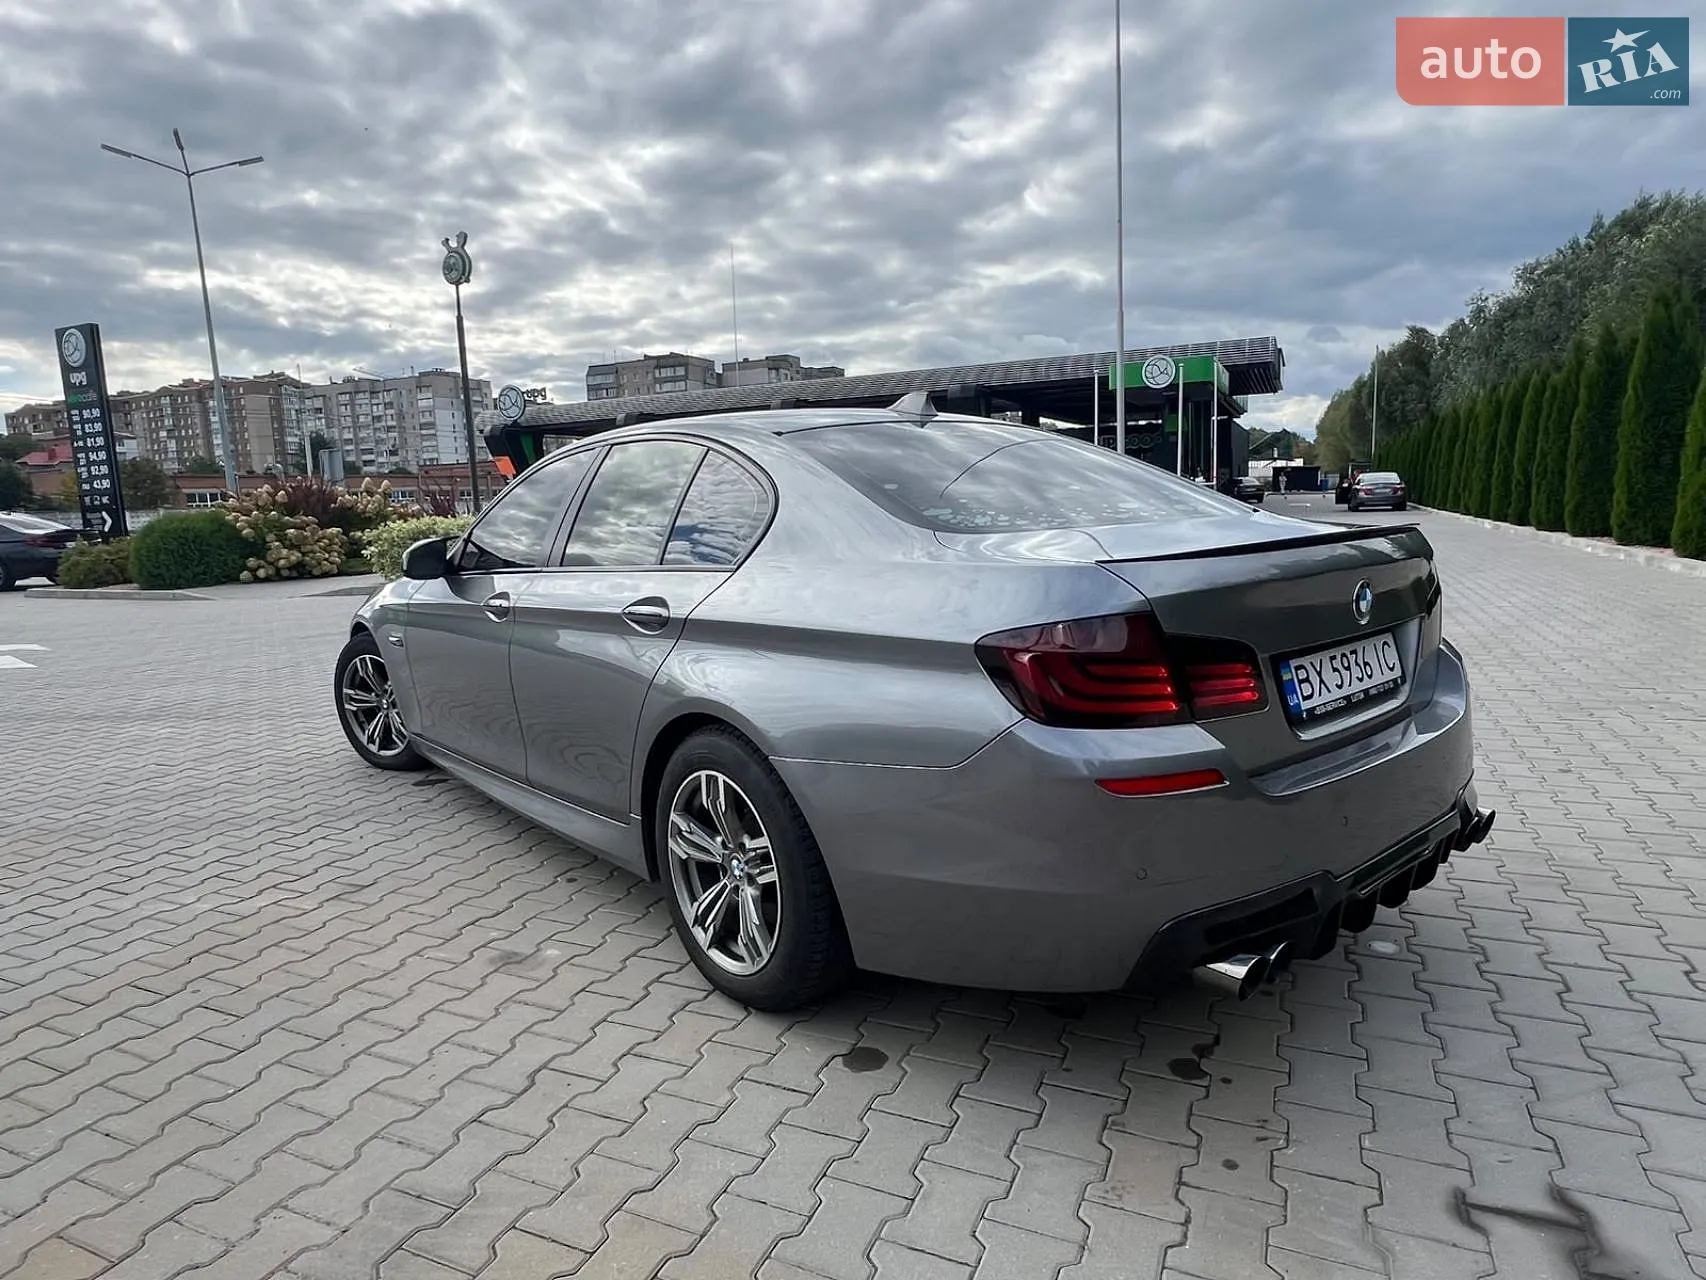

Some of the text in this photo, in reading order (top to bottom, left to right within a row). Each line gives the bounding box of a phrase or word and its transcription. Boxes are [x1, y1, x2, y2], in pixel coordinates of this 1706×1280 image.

[70, 371, 87, 386] upg
[1294, 640, 1396, 702] BX 5936 IC
[1287, 693, 1299, 706] UA
